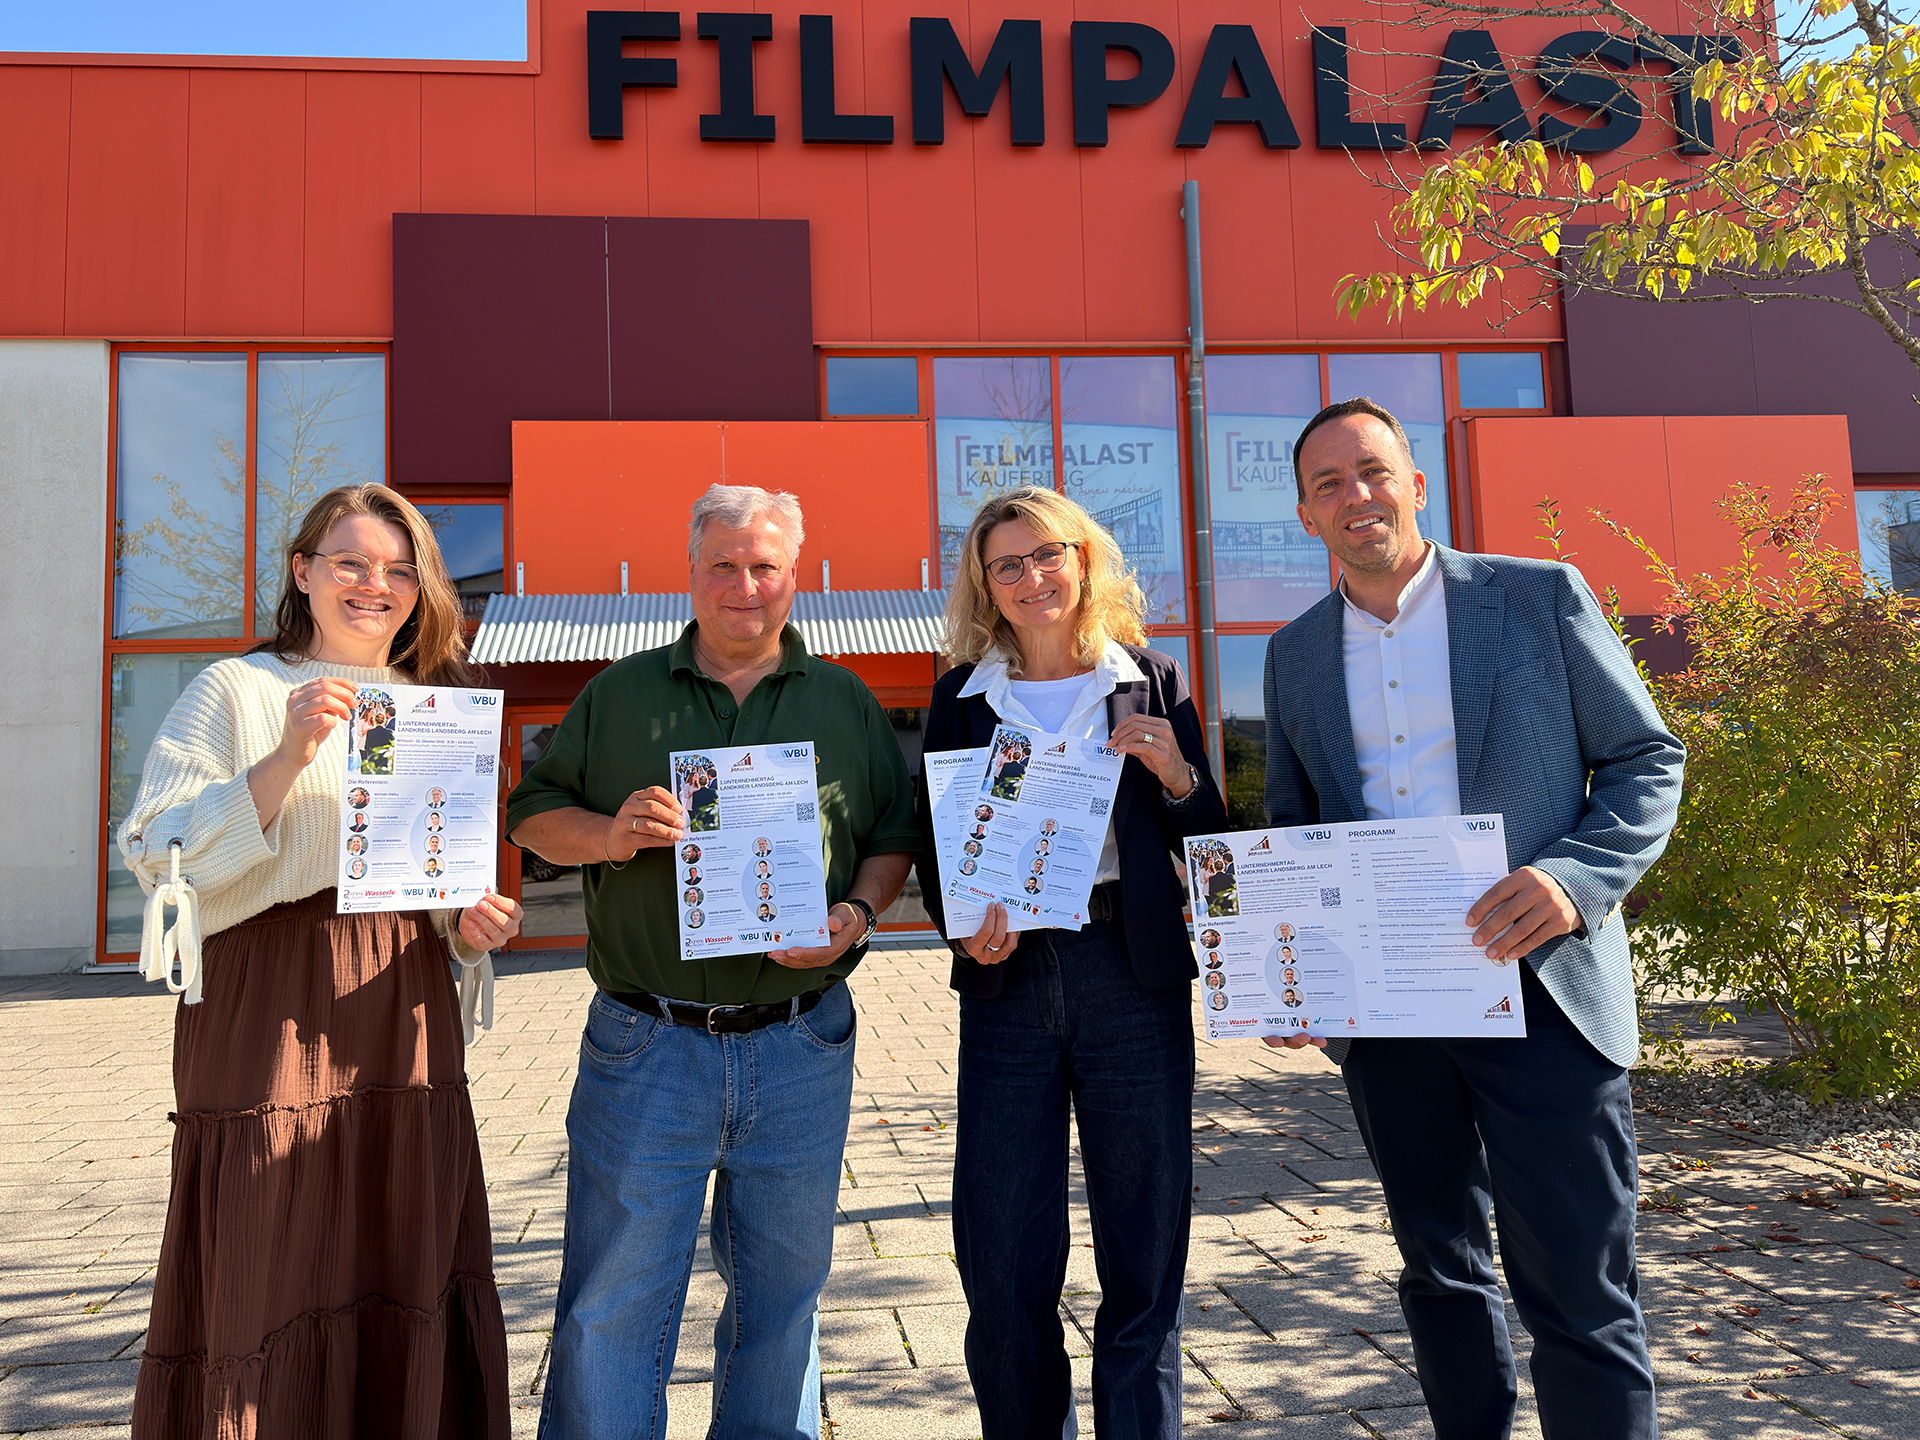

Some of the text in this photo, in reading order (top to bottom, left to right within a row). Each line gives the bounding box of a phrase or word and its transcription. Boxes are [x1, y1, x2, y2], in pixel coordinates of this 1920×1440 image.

[587, 10, 1743, 156] FILMPALAST
[966, 470, 1083, 487] KAUFERIG
[934, 757, 974, 766] PROGRAMM
[1029, 765, 1057, 773] LANDKREIS
[1058, 770, 1087, 779] LANDSBERG
[720, 783, 751, 791] LANDKREIS
[1466, 821, 1496, 831] VBU
[1348, 828, 1396, 838] PROGRAMM
[1270, 865, 1306, 873] LANDSBERG
[970, 886, 996, 899] Wasserle
[705, 935, 733, 943] Wasserle
